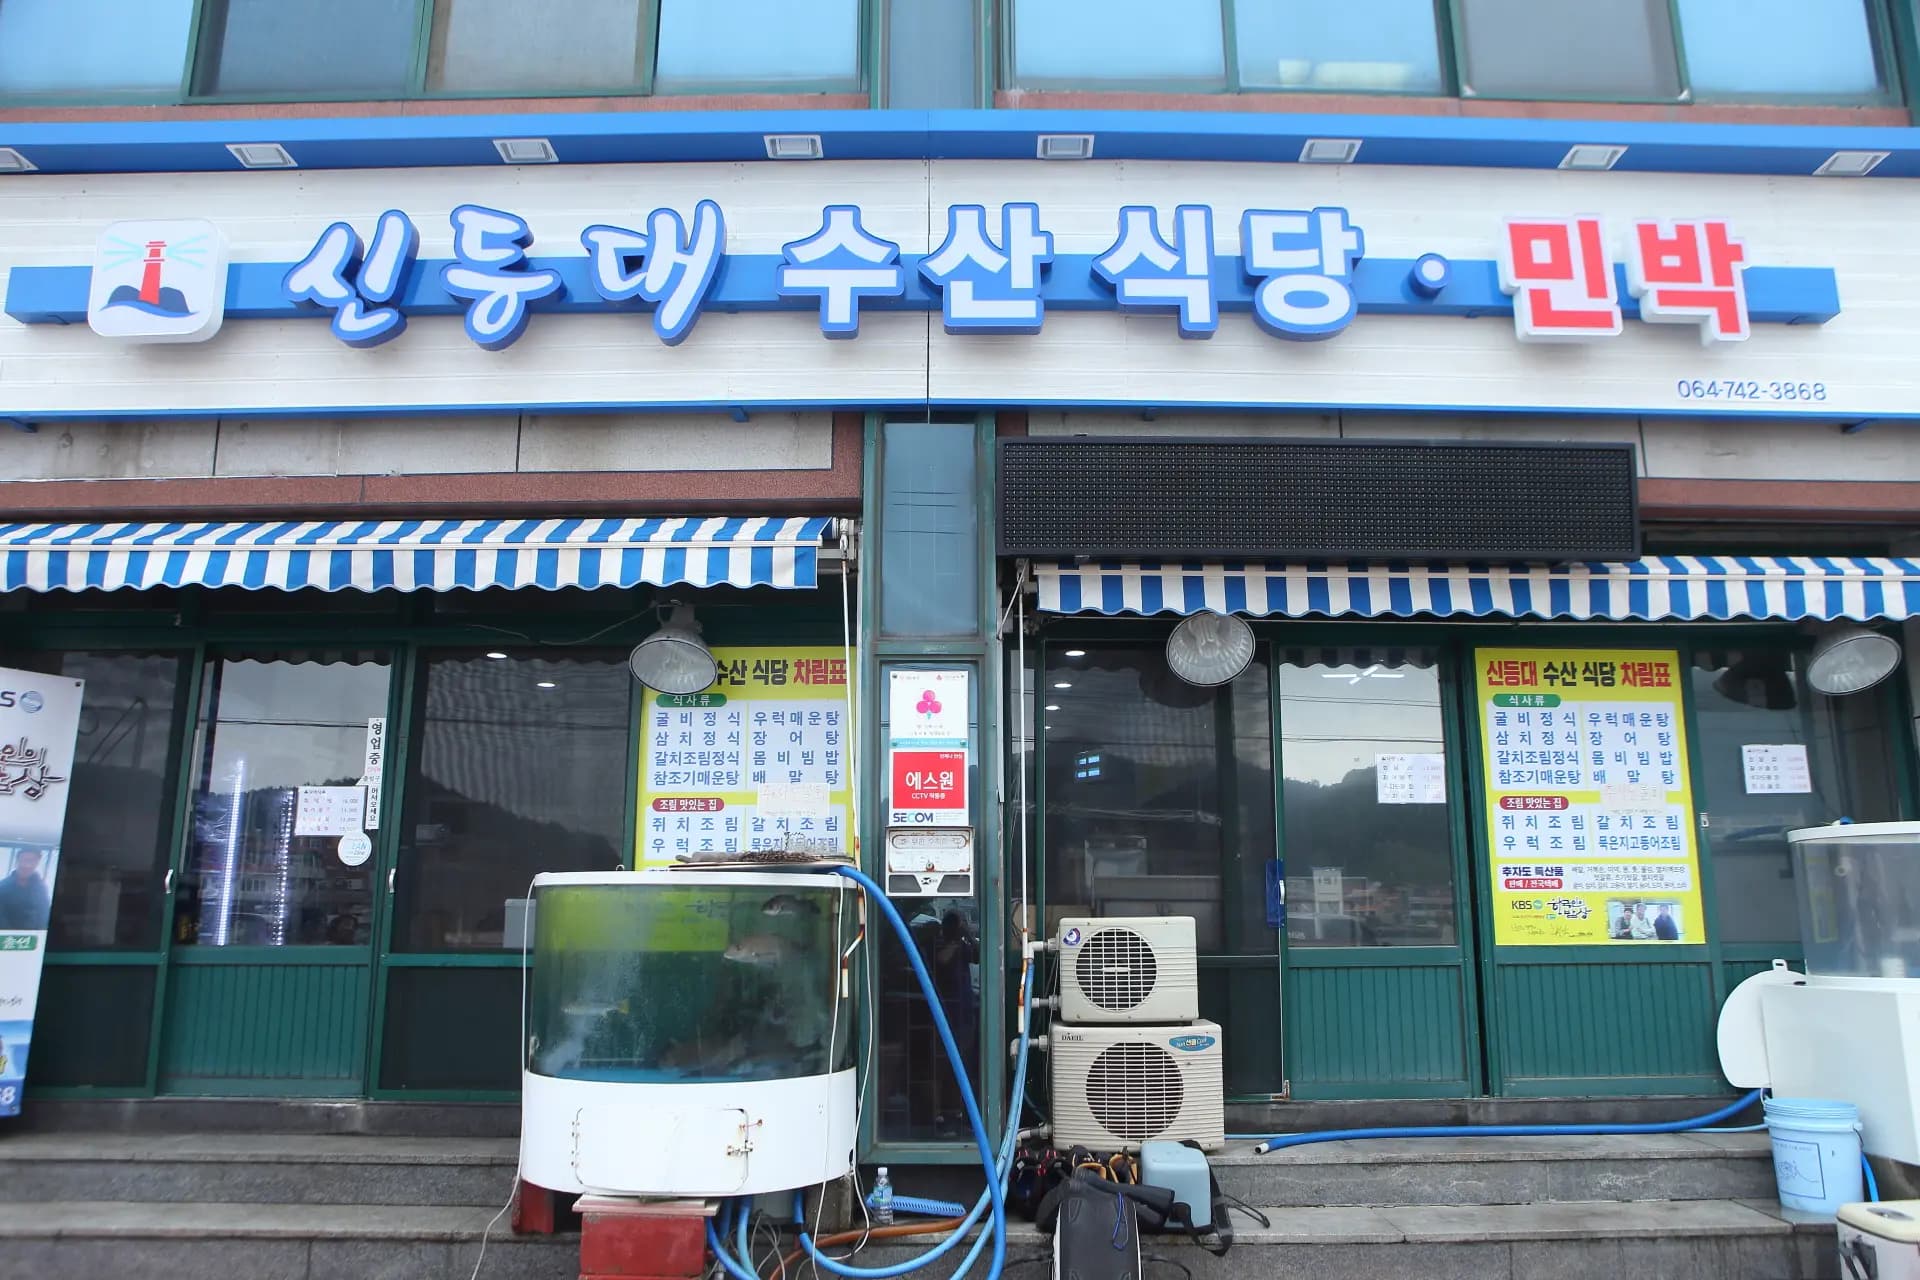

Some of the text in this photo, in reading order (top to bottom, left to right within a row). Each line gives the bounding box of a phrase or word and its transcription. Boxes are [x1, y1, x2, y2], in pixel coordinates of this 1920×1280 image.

[284, 200, 728, 350] 신등대
[1502, 216, 1750, 342] 민박
[1677, 379, 1827, 400] 064-742-3868
[715, 658, 846, 686] 수산 식당 차림표
[1486, 660, 1672, 687] 신등대 수산 식당 차림표
[672, 694, 711, 707] 식사류
[1508, 694, 1545, 707] 식사류
[655, 711, 741, 727] 굴비정식
[753, 711, 840, 727] 우럭매운탕
[1494, 711, 1576, 727] 굴비정식
[1588, 711, 1669, 728] 우럭매운탕
[369, 722, 383, 765] 영업중
[655, 731, 741, 747] 삼치정식
[1496, 730, 1578, 746] 삼치정식
[654, 750, 740, 766] 갈치조림정식
[1497, 750, 1579, 765] 갈치조림정식
[653, 770, 740, 786] 참조기매운탕
[905, 770, 954, 790] 에스원
[1499, 769, 1581, 785] 참조기매운탕
[911, 792, 928, 800] CCTV
[1506, 798, 1562, 809] 조림 맛있는 집
[660, 800, 717, 811] 조림 맛있는 집
[652, 816, 739, 832] 쥐치조림
[752, 816, 839, 832] 갈치조림
[893, 812, 934, 823] SECOM
[1502, 815, 1584, 830] 쥐치조림
[1597, 815, 1680, 830] 갈치조림
[651, 837, 738, 853] 우럭조림
[1503, 835, 1586, 851] 우럭조림
[1599, 835, 1681, 851] 묵은지고등어조림
[1502, 866, 1531, 877] 추자도
[1535, 866, 1564, 877] 특산품
[1511, 900, 1533, 910] KBS
